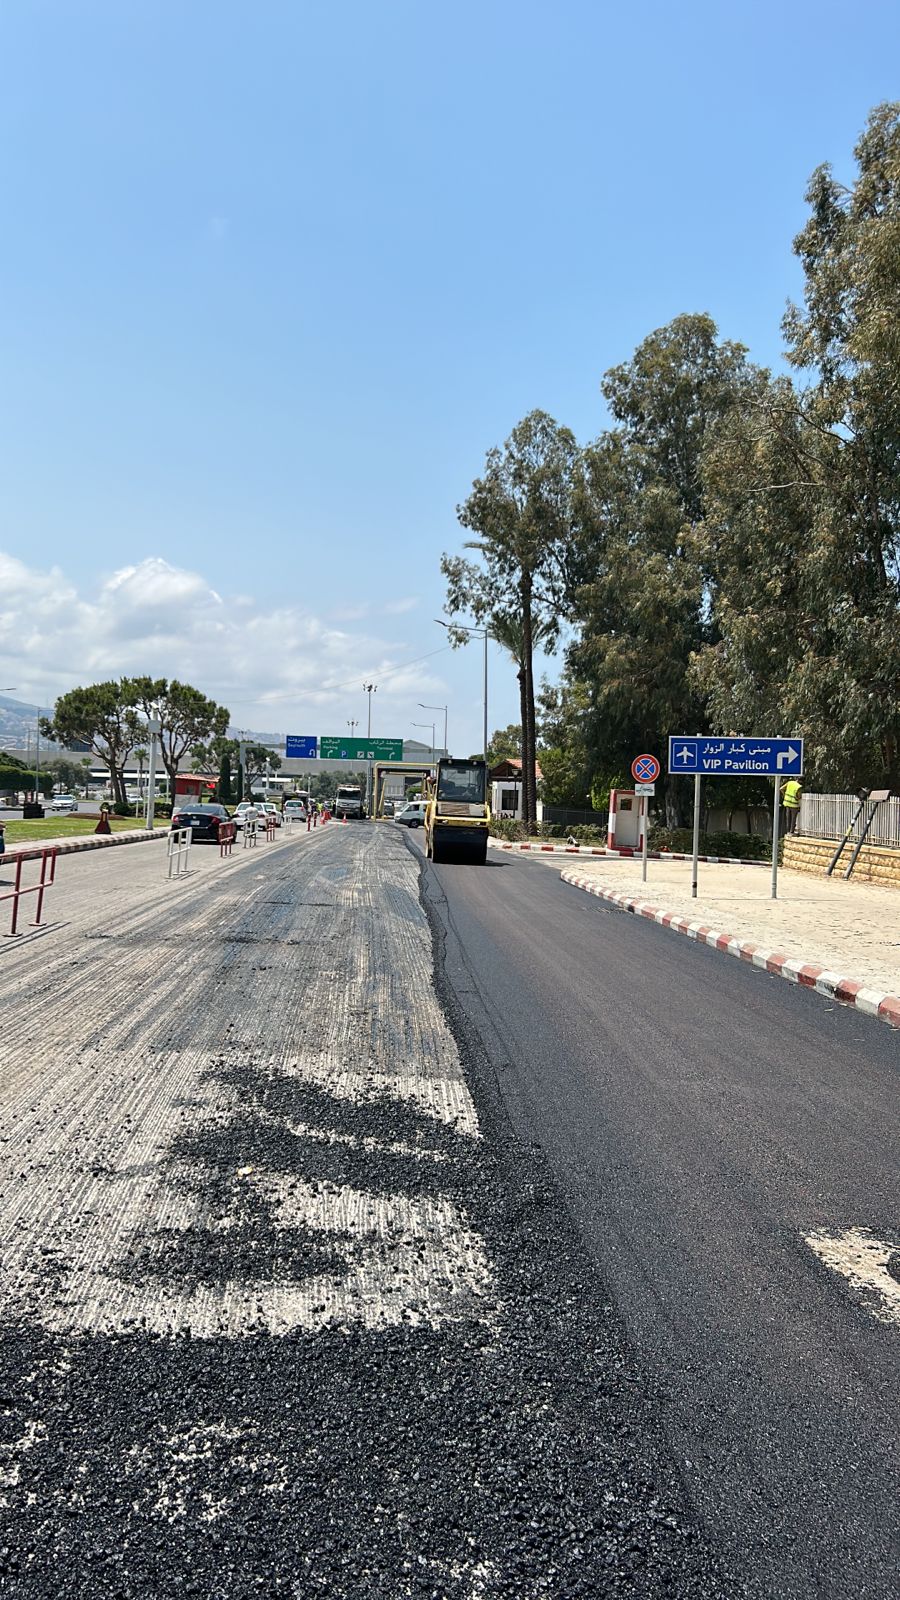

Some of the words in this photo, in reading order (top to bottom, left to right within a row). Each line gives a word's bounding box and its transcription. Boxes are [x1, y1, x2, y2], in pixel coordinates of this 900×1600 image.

[702, 742, 724, 754] الزوار
[727, 743, 746, 754] كبار
[702, 758, 722, 769] VIP
[724, 759, 769, 770] Pavilion
